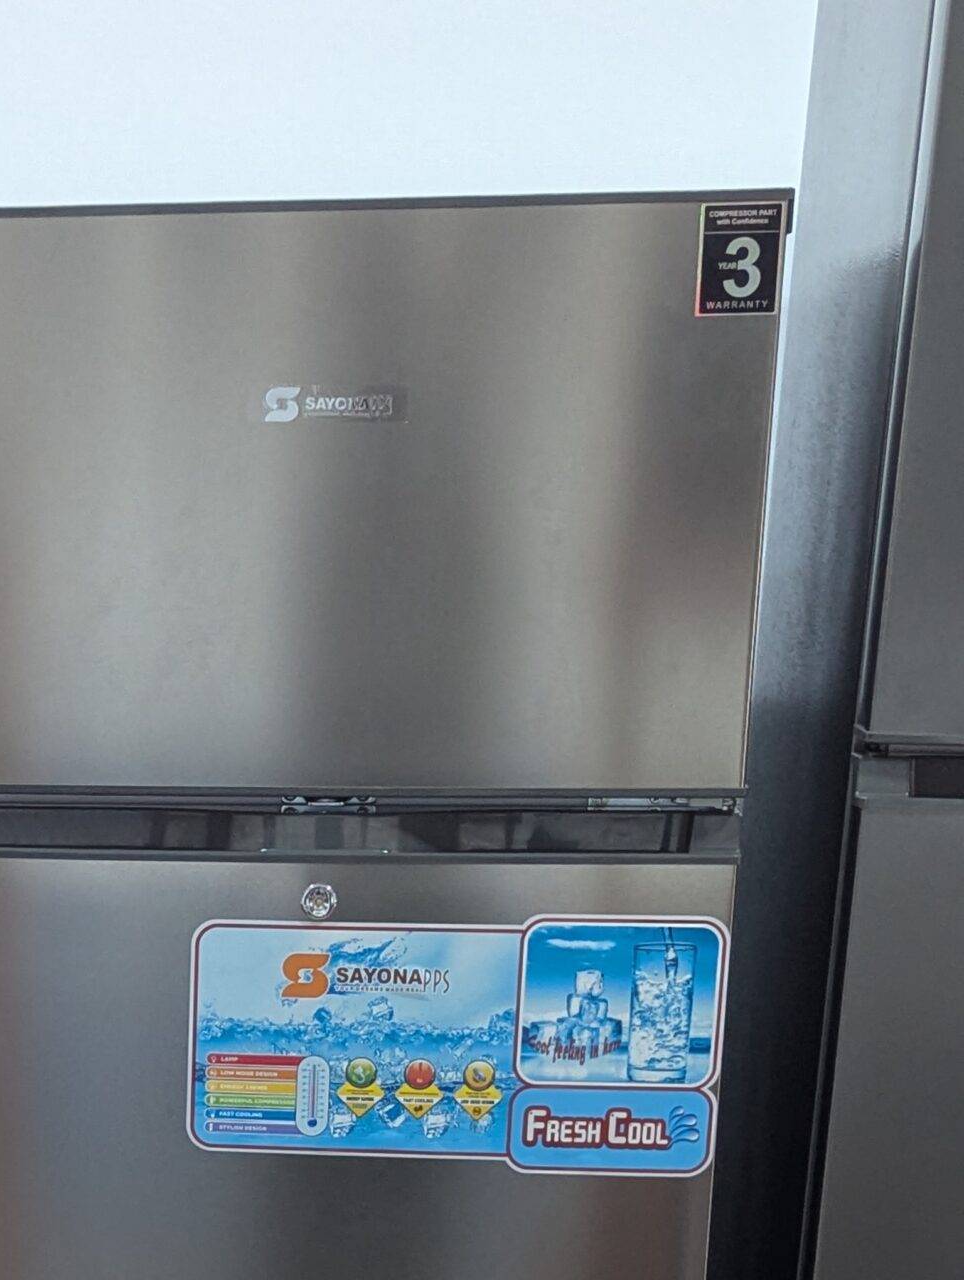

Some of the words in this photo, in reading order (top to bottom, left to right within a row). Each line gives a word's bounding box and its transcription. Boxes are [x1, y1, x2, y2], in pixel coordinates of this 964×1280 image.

[723, 236, 761, 298] 3
[706, 300, 769, 310] WARRANTY
[526, 1109, 601, 1143] FRESH
[608, 1111, 669, 1146] COOL
